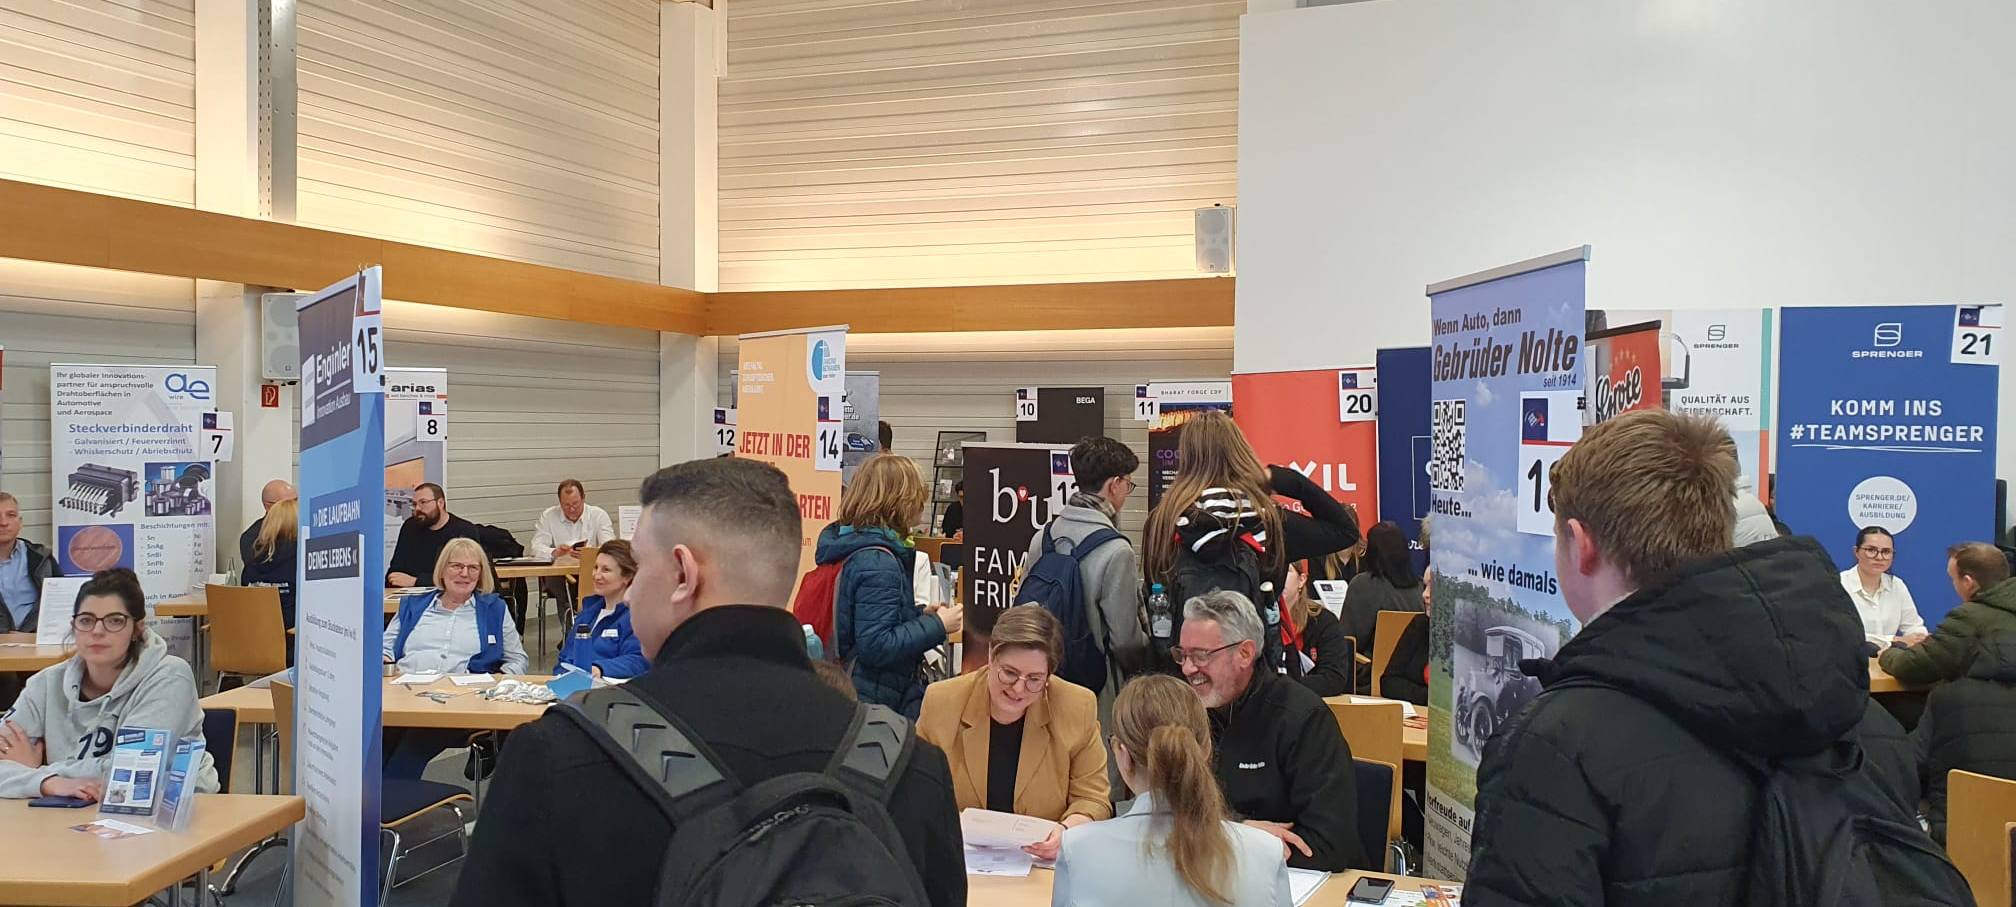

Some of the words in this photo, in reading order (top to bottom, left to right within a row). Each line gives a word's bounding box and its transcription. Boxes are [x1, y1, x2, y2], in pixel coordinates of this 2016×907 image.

[1434, 318, 1458, 336] Wenn
[1462, 312, 1490, 332] Auto,
[1493, 307, 1521, 328] dann
[357, 327, 377, 373] 15
[1960, 333, 1992, 355] 21
[1434, 337, 1512, 382] Gebrüder
[1517, 328, 1578, 374] Nolte
[391, 382, 435, 392] arias
[1543, 376, 1556, 387] seit
[1558, 374, 1577, 387] 1914
[1020, 402, 1035, 416] 10
[1139, 402, 1154, 415] 11
[1346, 394, 1372, 414] 20
[1681, 394, 1726, 405] QUALITÄT
[1731, 396, 1749, 404] AUS
[1831, 400, 1894, 416] KOMM
[1904, 400, 1942, 416] INS
[69, 423, 192, 433] Steckverbinderdraht
[428, 419, 437, 435] 8
[717, 428, 735, 446] 12
[1790, 424, 1984, 442] #TEAMSPRENGER
[212, 435, 223, 453] 7
[740, 432, 769, 455] JETZT
[772, 433, 782, 456] IN
[787, 434, 810, 458] DER
[820, 430, 839, 459] 14
[1528, 459, 1556, 512] 1
[318, 508, 327, 527] DIE
[329, 499, 360, 525] LAUFBAHN
[800, 494, 831, 520] RTEN
[308, 550, 328, 570] DEINES
[329, 547, 351, 568] LEBENS
[1481, 562, 1505, 582] wie
[1508, 564, 1557, 595] damals
[78, 726, 113, 760] 19
[1459, 816, 1471, 832] auf
